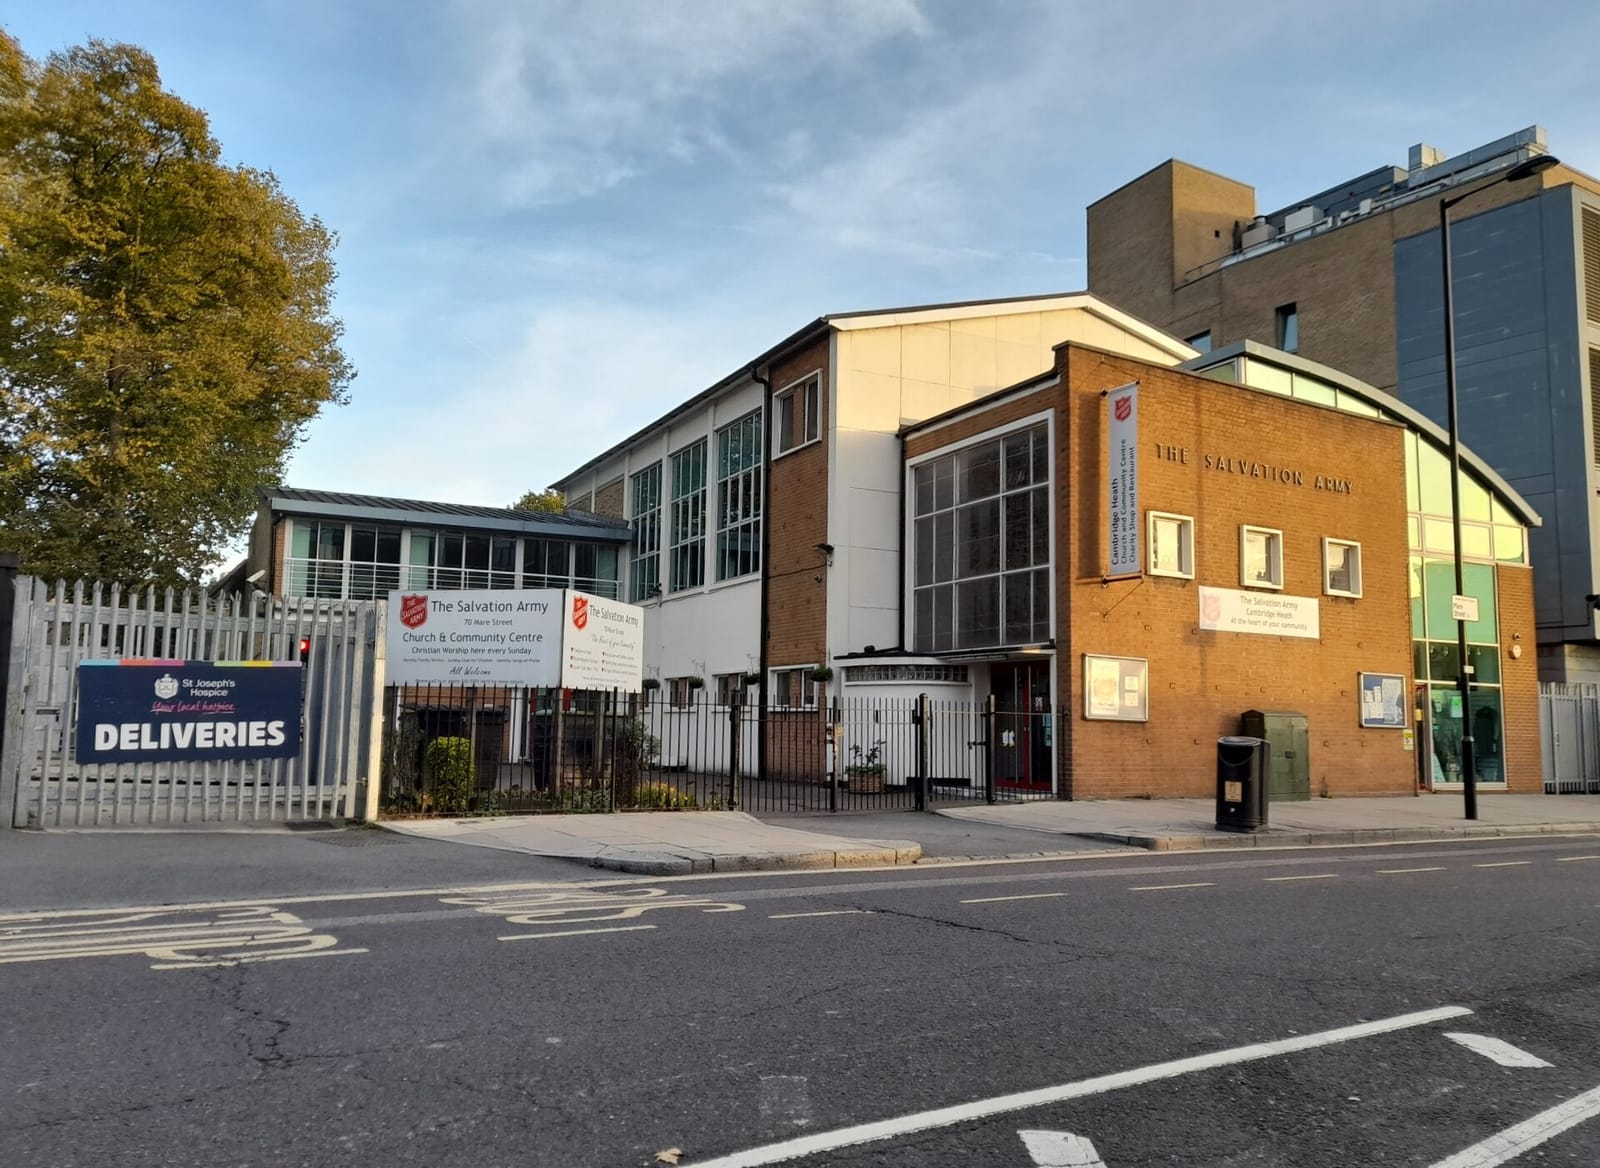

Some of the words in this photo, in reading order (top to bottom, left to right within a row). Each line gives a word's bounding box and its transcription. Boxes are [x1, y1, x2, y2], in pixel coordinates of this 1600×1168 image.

[1155, 443, 1189, 464] THE
[1204, 453, 1304, 485] SALVATION
[1314, 475, 1353, 495] ARMY
[1111, 478, 1119, 509] Heath
[1120, 469, 1128, 515] Community
[1128, 510, 1136, 531] Shop
[1111, 512, 1120, 565] Cambridge
[406, 598, 417, 609] THE
[432, 600, 453, 612] The
[457, 600, 513, 613] Salvation
[516, 601, 549, 615] Army
[1239, 595, 1252, 603] The
[1253, 597, 1281, 608] Salvation
[1282, 600, 1298, 610] Army
[409, 610, 424, 624] ARMY
[589, 604, 600, 618] The
[601, 607, 624, 623] Salvation
[625, 615, 639, 628] Army
[1246, 608, 1275, 619] Cambridge
[1276, 611, 1293, 619] Heath
[1247, 618, 1261, 626] heart
[1281, 622, 1308, 631] community
[402, 632, 436, 642] Church
[439, 632, 446, 642] &
[449, 632, 506, 644] Community
[509, 632, 543, 642] Centre
[411, 646, 440, 654] Christian
[442, 647, 469, 655] Worship
[507, 647, 532, 655] Sunday
[449, 666, 463, 675] All
[464, 666, 491, 675] Welcome
[182, 678, 193, 688] St
[194, 678, 236, 691] Joseph's
[190, 687, 228, 697] Hospice
[151, 701, 174, 715] Your
[177, 701, 200, 712] local
[94, 720, 286, 751] DELIVERIES
